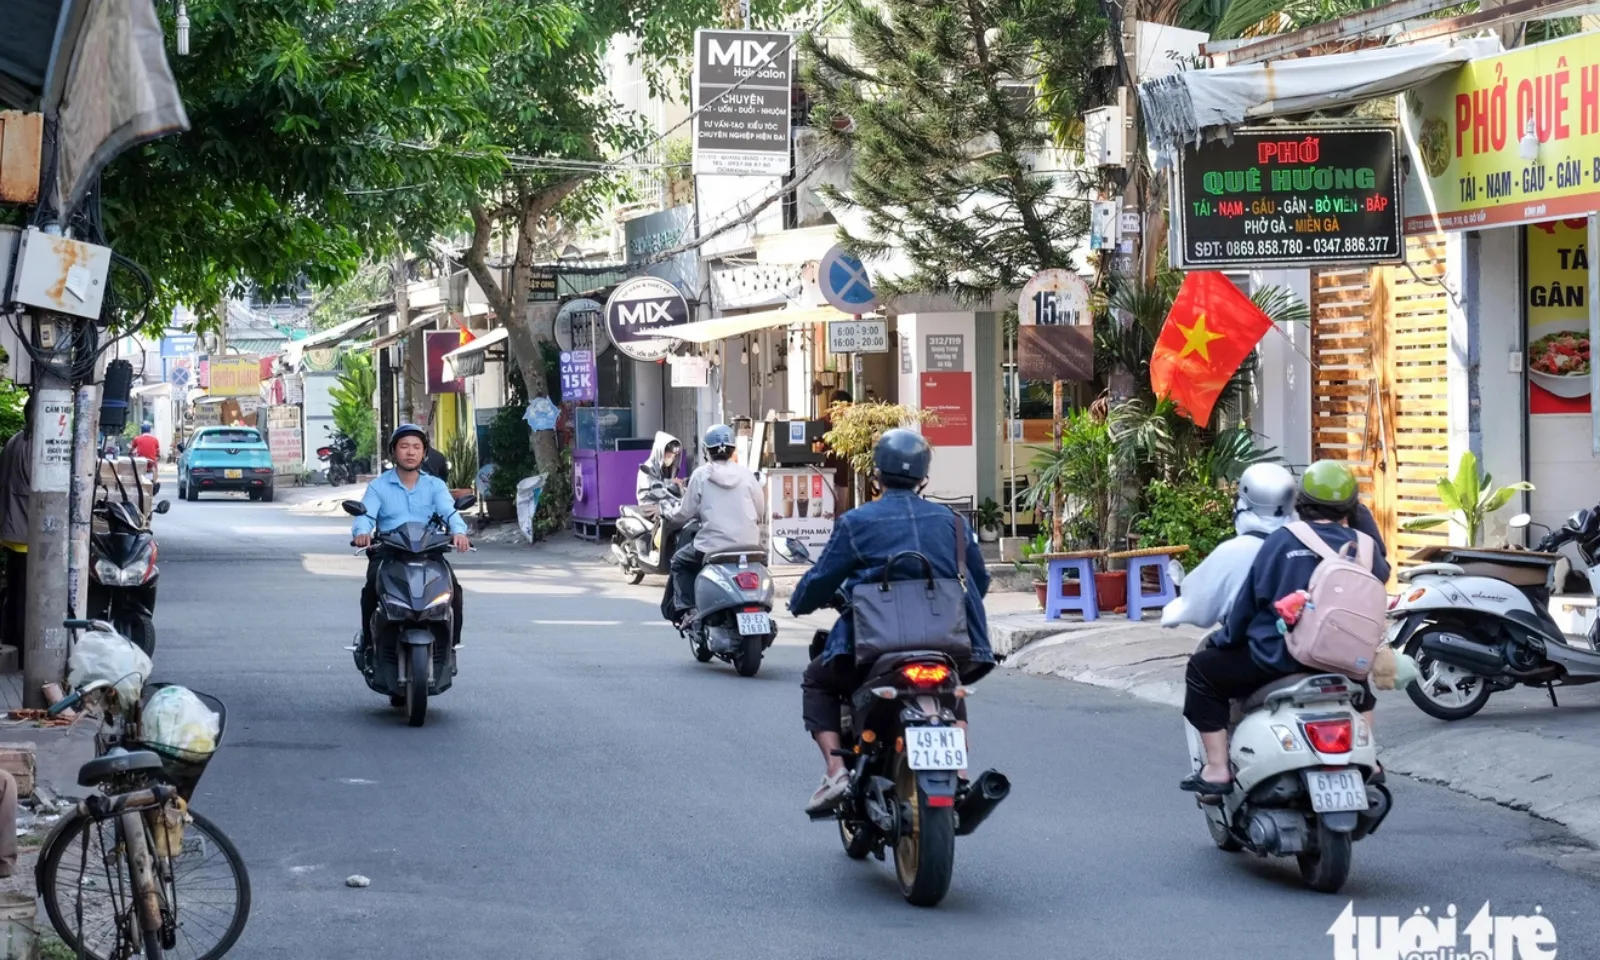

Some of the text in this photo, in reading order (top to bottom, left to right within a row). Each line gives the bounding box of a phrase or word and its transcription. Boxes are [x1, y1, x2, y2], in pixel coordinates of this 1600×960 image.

[708, 39, 777, 68] MIX
[756, 69, 786, 79] Salon
[721, 93, 764, 106] CHUYÊN
[1455, 62, 1508, 158] PHỞ
[1580, 64, 1599, 136] H
[1257, 136, 1319, 164] PHỞ
[1203, 166, 1375, 195] QUÊ HƯƠNG
[1460, 172, 1476, 203] TÁI
[1486, 171, 1511, 203] NẠM
[1557, 155, 1581, 188] GÂN
[1193, 198, 1210, 217] TÁI
[1218, 201, 1243, 219] NẠM
[1283, 196, 1307, 214] GÂN
[1315, 195, 1331, 213] BÒ
[1333, 195, 1358, 213] VIÊN
[1270, 216, 1287, 233] GÀ
[1295, 214, 1321, 232] MIỀN
[1323, 214, 1340, 232] GÀ
[1195, 236, 1389, 257] SĐT: 0869.858.780 0347.886.377
[1530, 281, 1584, 307] GÂN
[618, 300, 674, 325] MIX
[1032, 291, 1056, 325] 15
[837, 326, 879, 336] 6:00 9:00
[833, 337, 884, 347] 16:00 20:00
[929, 337, 961, 346] 312/119
[562, 363, 590, 373] CÀ PHÊ
[562, 374, 591, 388] 15K
[776, 527, 786, 535] CÀ
[787, 526, 800, 535] PHÊ
[816, 527, 831, 535] MÁY
[917, 731, 955, 748] 49-N1
[912, 750, 964, 767] 214.69
[1315, 791, 1363, 809] 387.05
